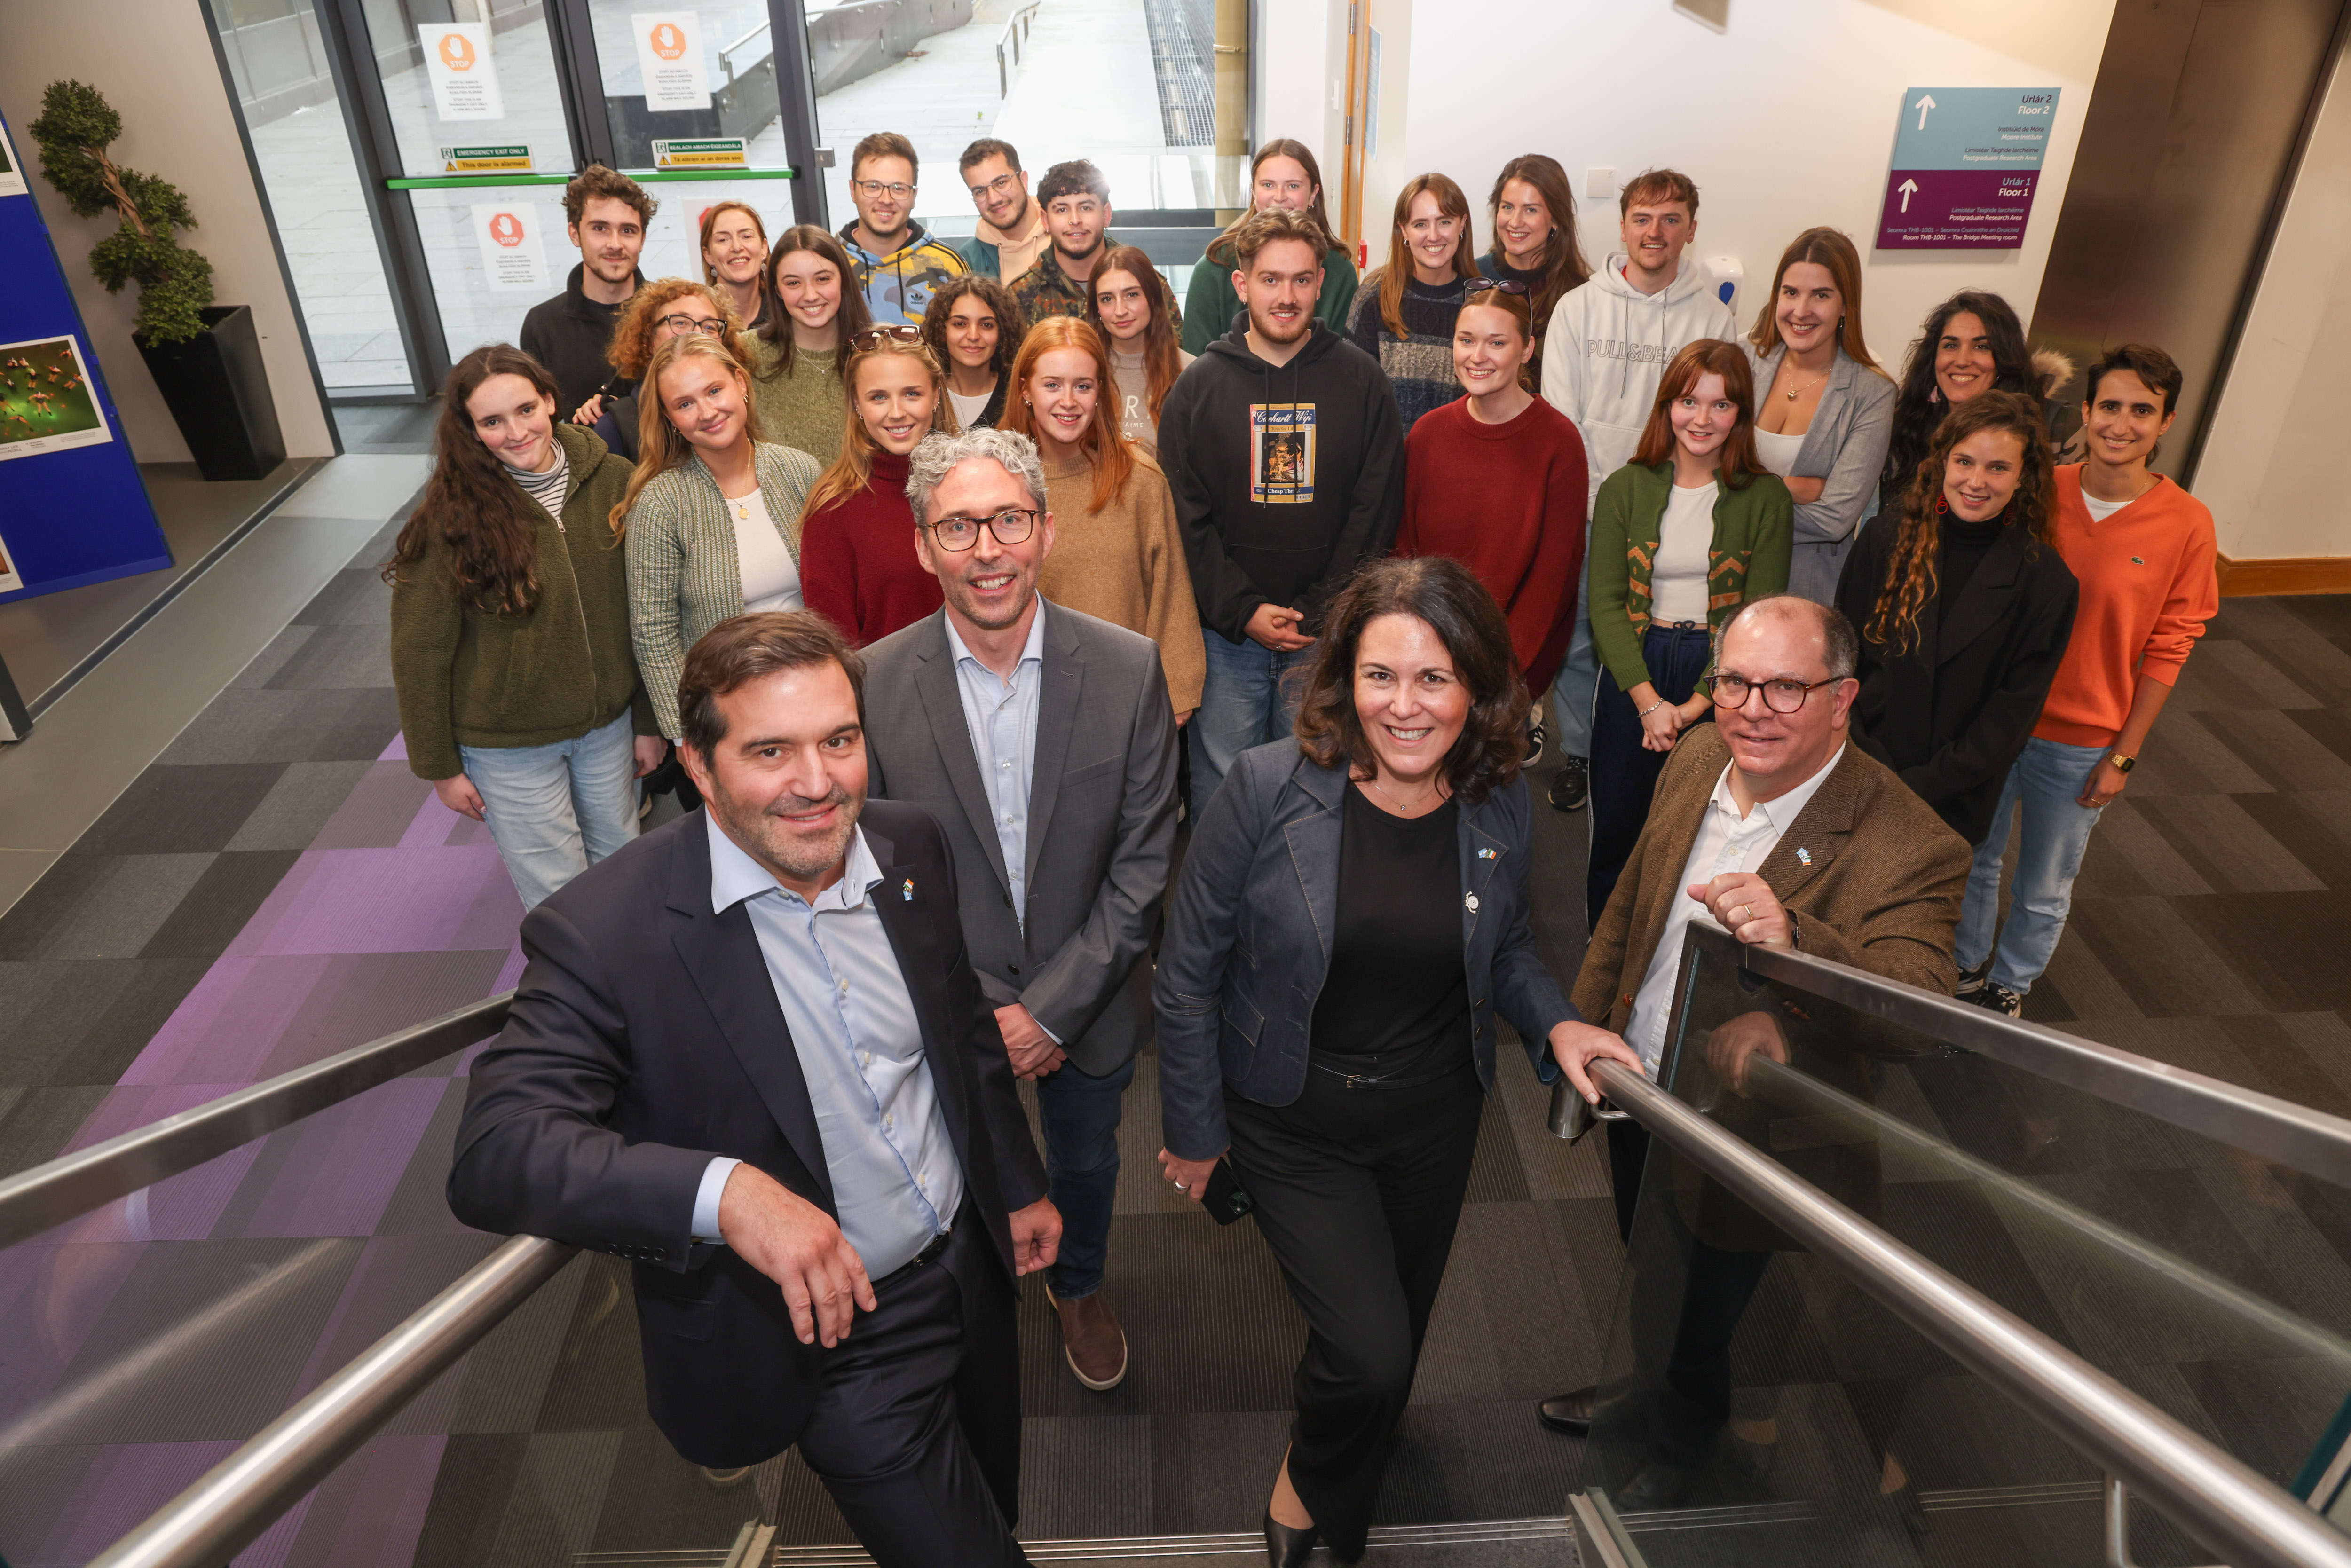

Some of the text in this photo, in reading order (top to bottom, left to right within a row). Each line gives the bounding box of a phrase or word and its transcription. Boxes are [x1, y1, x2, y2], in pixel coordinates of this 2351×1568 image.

[660, 49, 680, 57] STOP
[2018, 106, 2050, 114] Floor 2
[2002, 177, 2031, 186] Urlár 1
[1587, 339, 1680, 364] PULL&BEA
[1256, 411, 1292, 422] Carhartt
